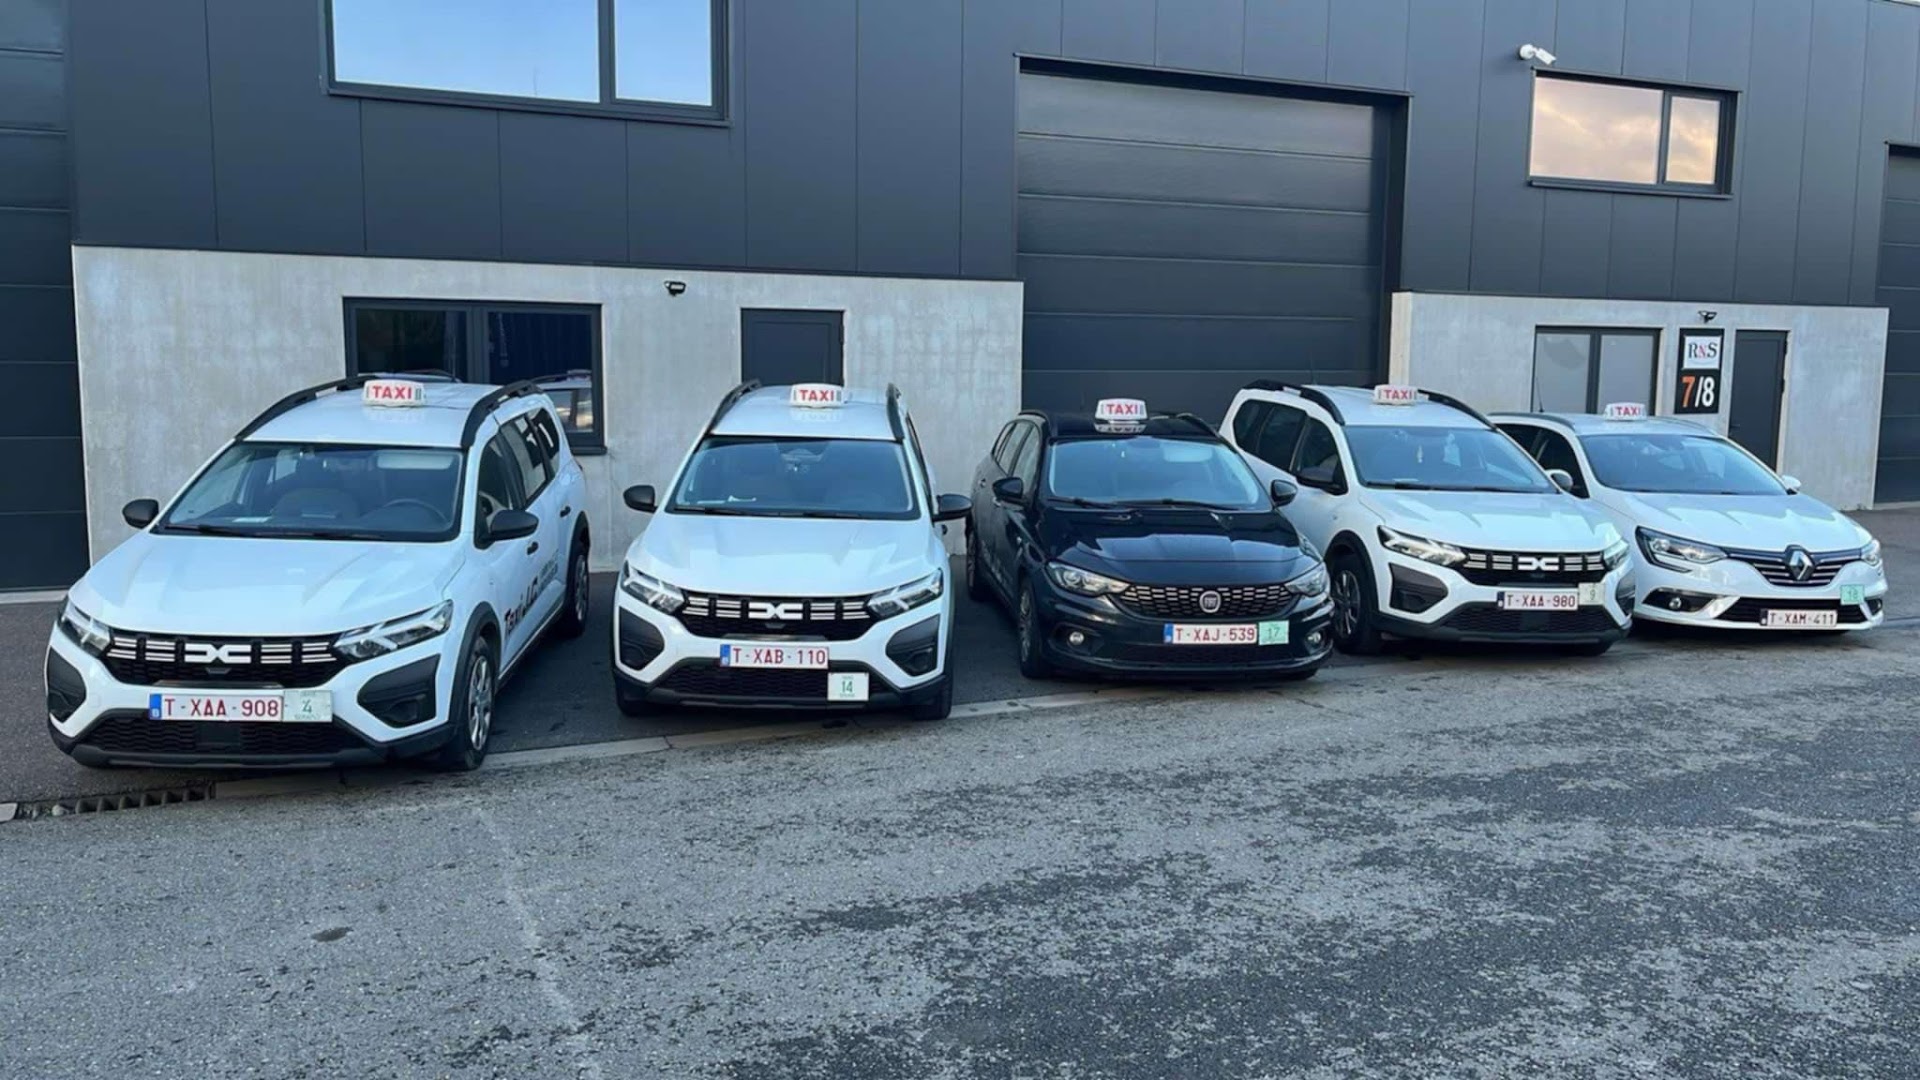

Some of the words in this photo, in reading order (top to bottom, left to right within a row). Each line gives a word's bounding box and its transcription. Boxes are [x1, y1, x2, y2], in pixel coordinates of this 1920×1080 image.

[372, 385, 412, 399] TAXI
[800, 389, 834, 401] TAXI
[1384, 389, 1412, 400] TAXI
[1682, 375, 1715, 407] 7/8
[1106, 404, 1138, 415] TAXI
[1615, 406, 1641, 416] TAXI
[841, 681, 853, 693] 14
[302, 699, 312, 713] 4
